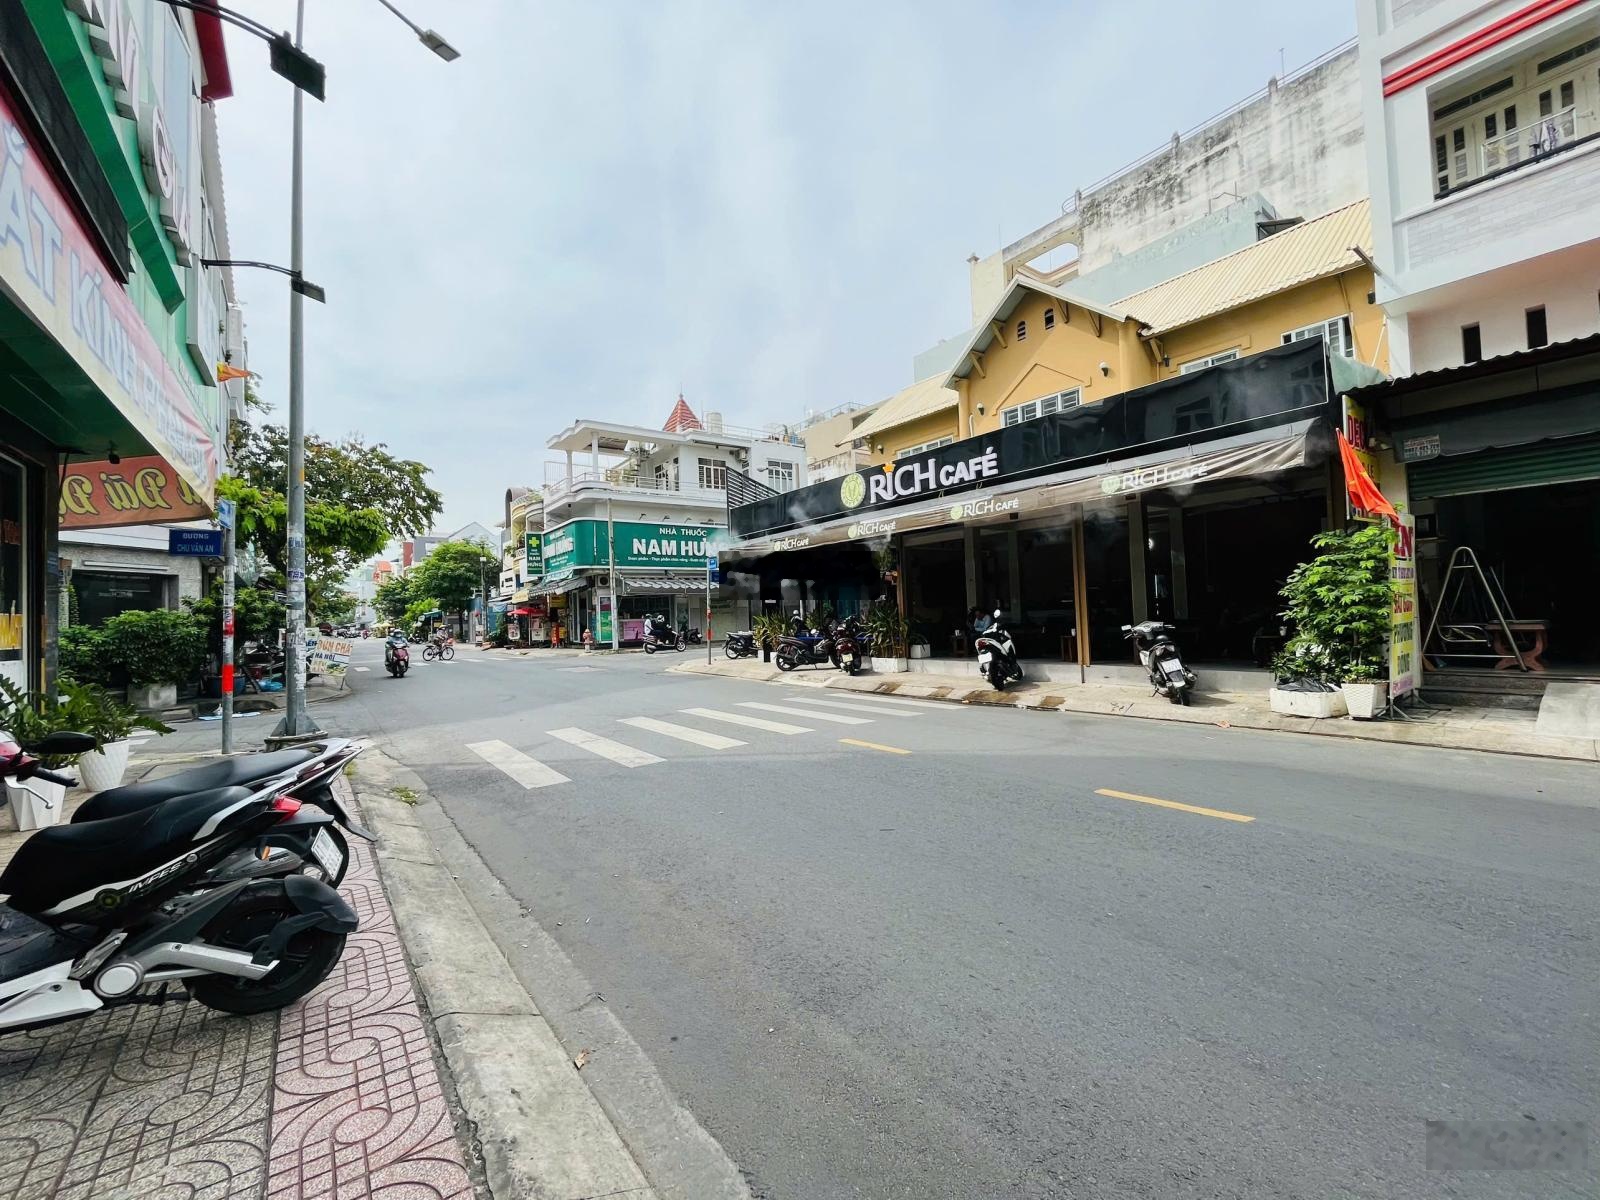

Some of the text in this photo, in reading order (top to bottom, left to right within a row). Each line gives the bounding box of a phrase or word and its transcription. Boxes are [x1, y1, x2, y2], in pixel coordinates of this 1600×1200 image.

[939, 446, 999, 486] CAFÉ
[995, 499, 1019, 510] CAFÉ
[659, 526, 708, 537] NHÀ THUỐC
[632, 538, 677, 556] NAM
